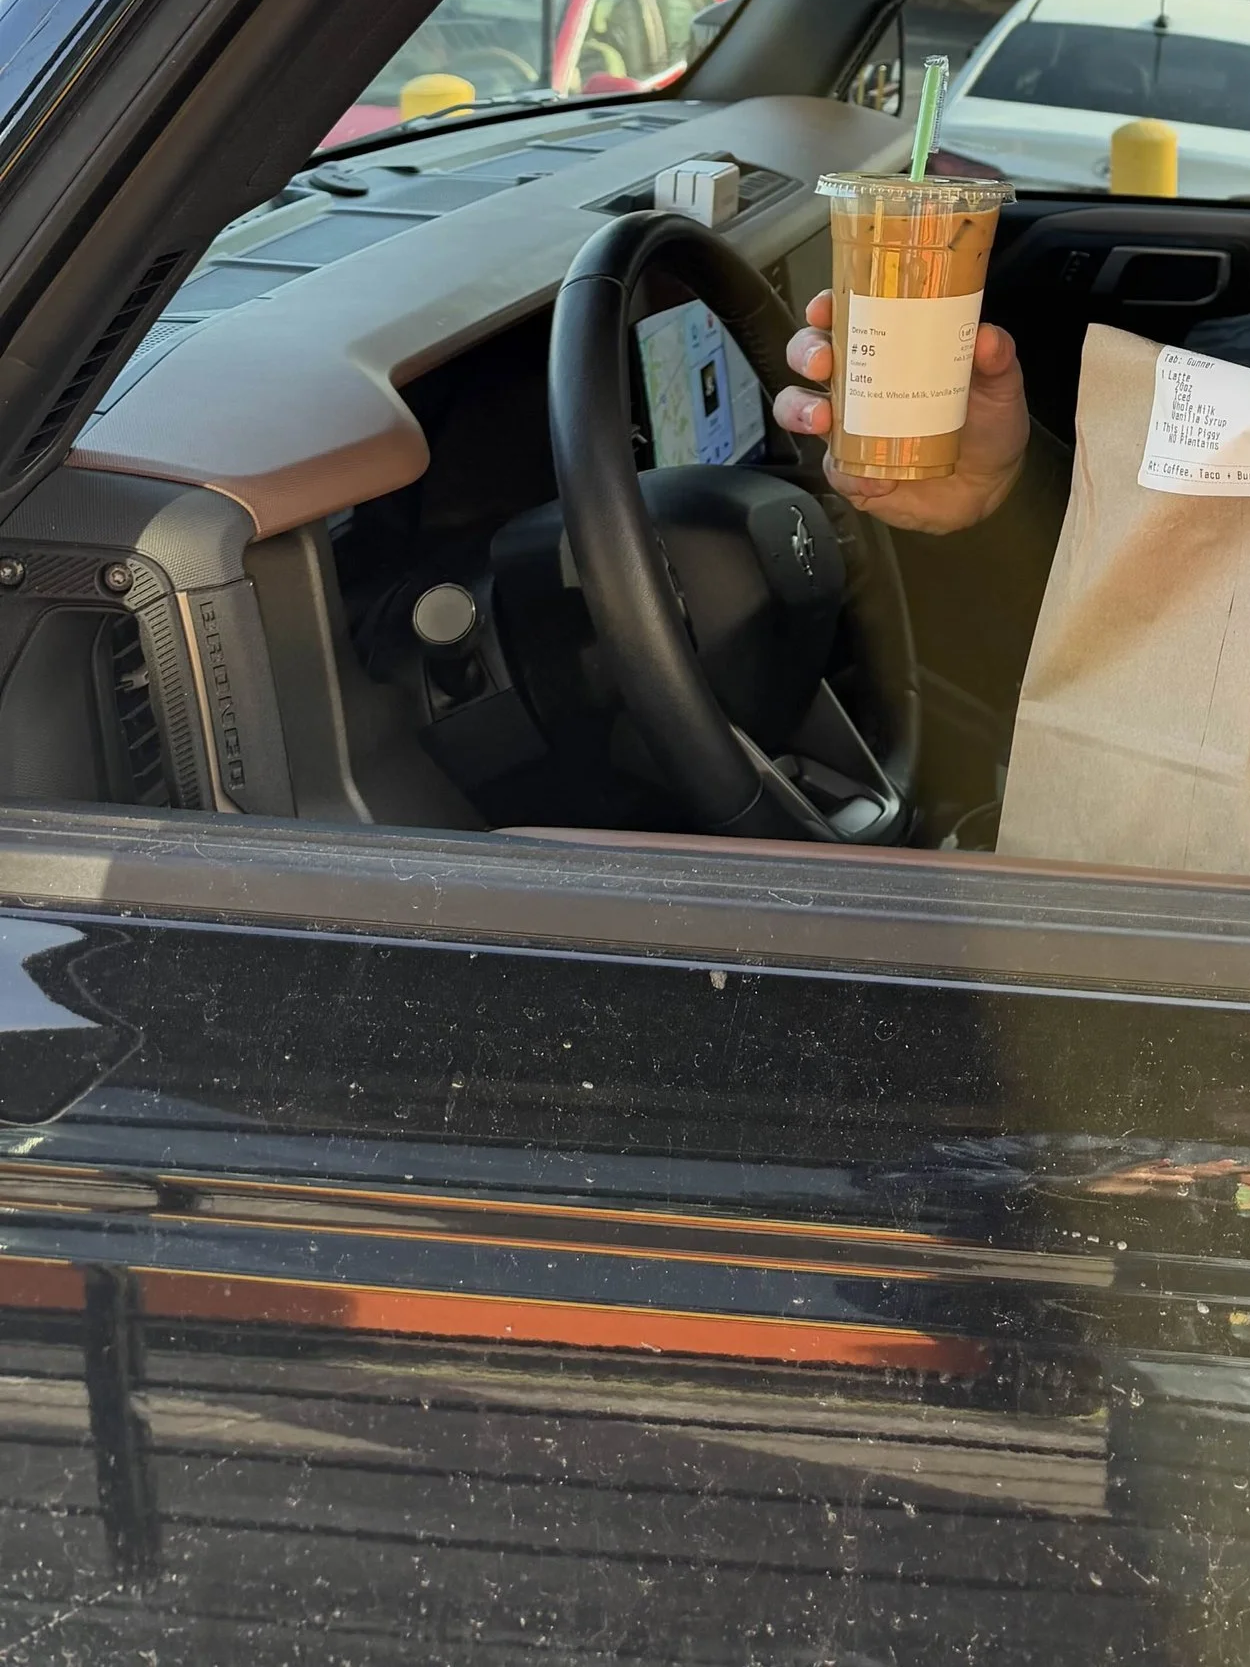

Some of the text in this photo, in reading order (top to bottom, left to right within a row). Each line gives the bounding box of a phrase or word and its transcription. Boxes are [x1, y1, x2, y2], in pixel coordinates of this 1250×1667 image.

[851, 326, 886, 337] Drive Thru
[851, 344, 876, 356] # 95
[1164, 353, 1215, 369] Tab: Gunner
[850, 372, 873, 384] Latte
[1168, 370, 1191, 383] Latte
[1174, 381, 1193, 393] 20oz
[886, 390, 910, 399] Whole
[1174, 390, 1191, 402] Iced
[1172, 400, 1216, 416] Whole Milk
[1171, 410, 1228, 428] Vanilla Syrup
[1163, 421, 1178, 434] This
[1197, 427, 1221, 441] Piggy
[1180, 434, 1219, 450] Plantains
[1148, 460, 1159, 473] At:
[1199, 468, 1221, 480] Taco
[200, 600, 246, 790] BRONCO
